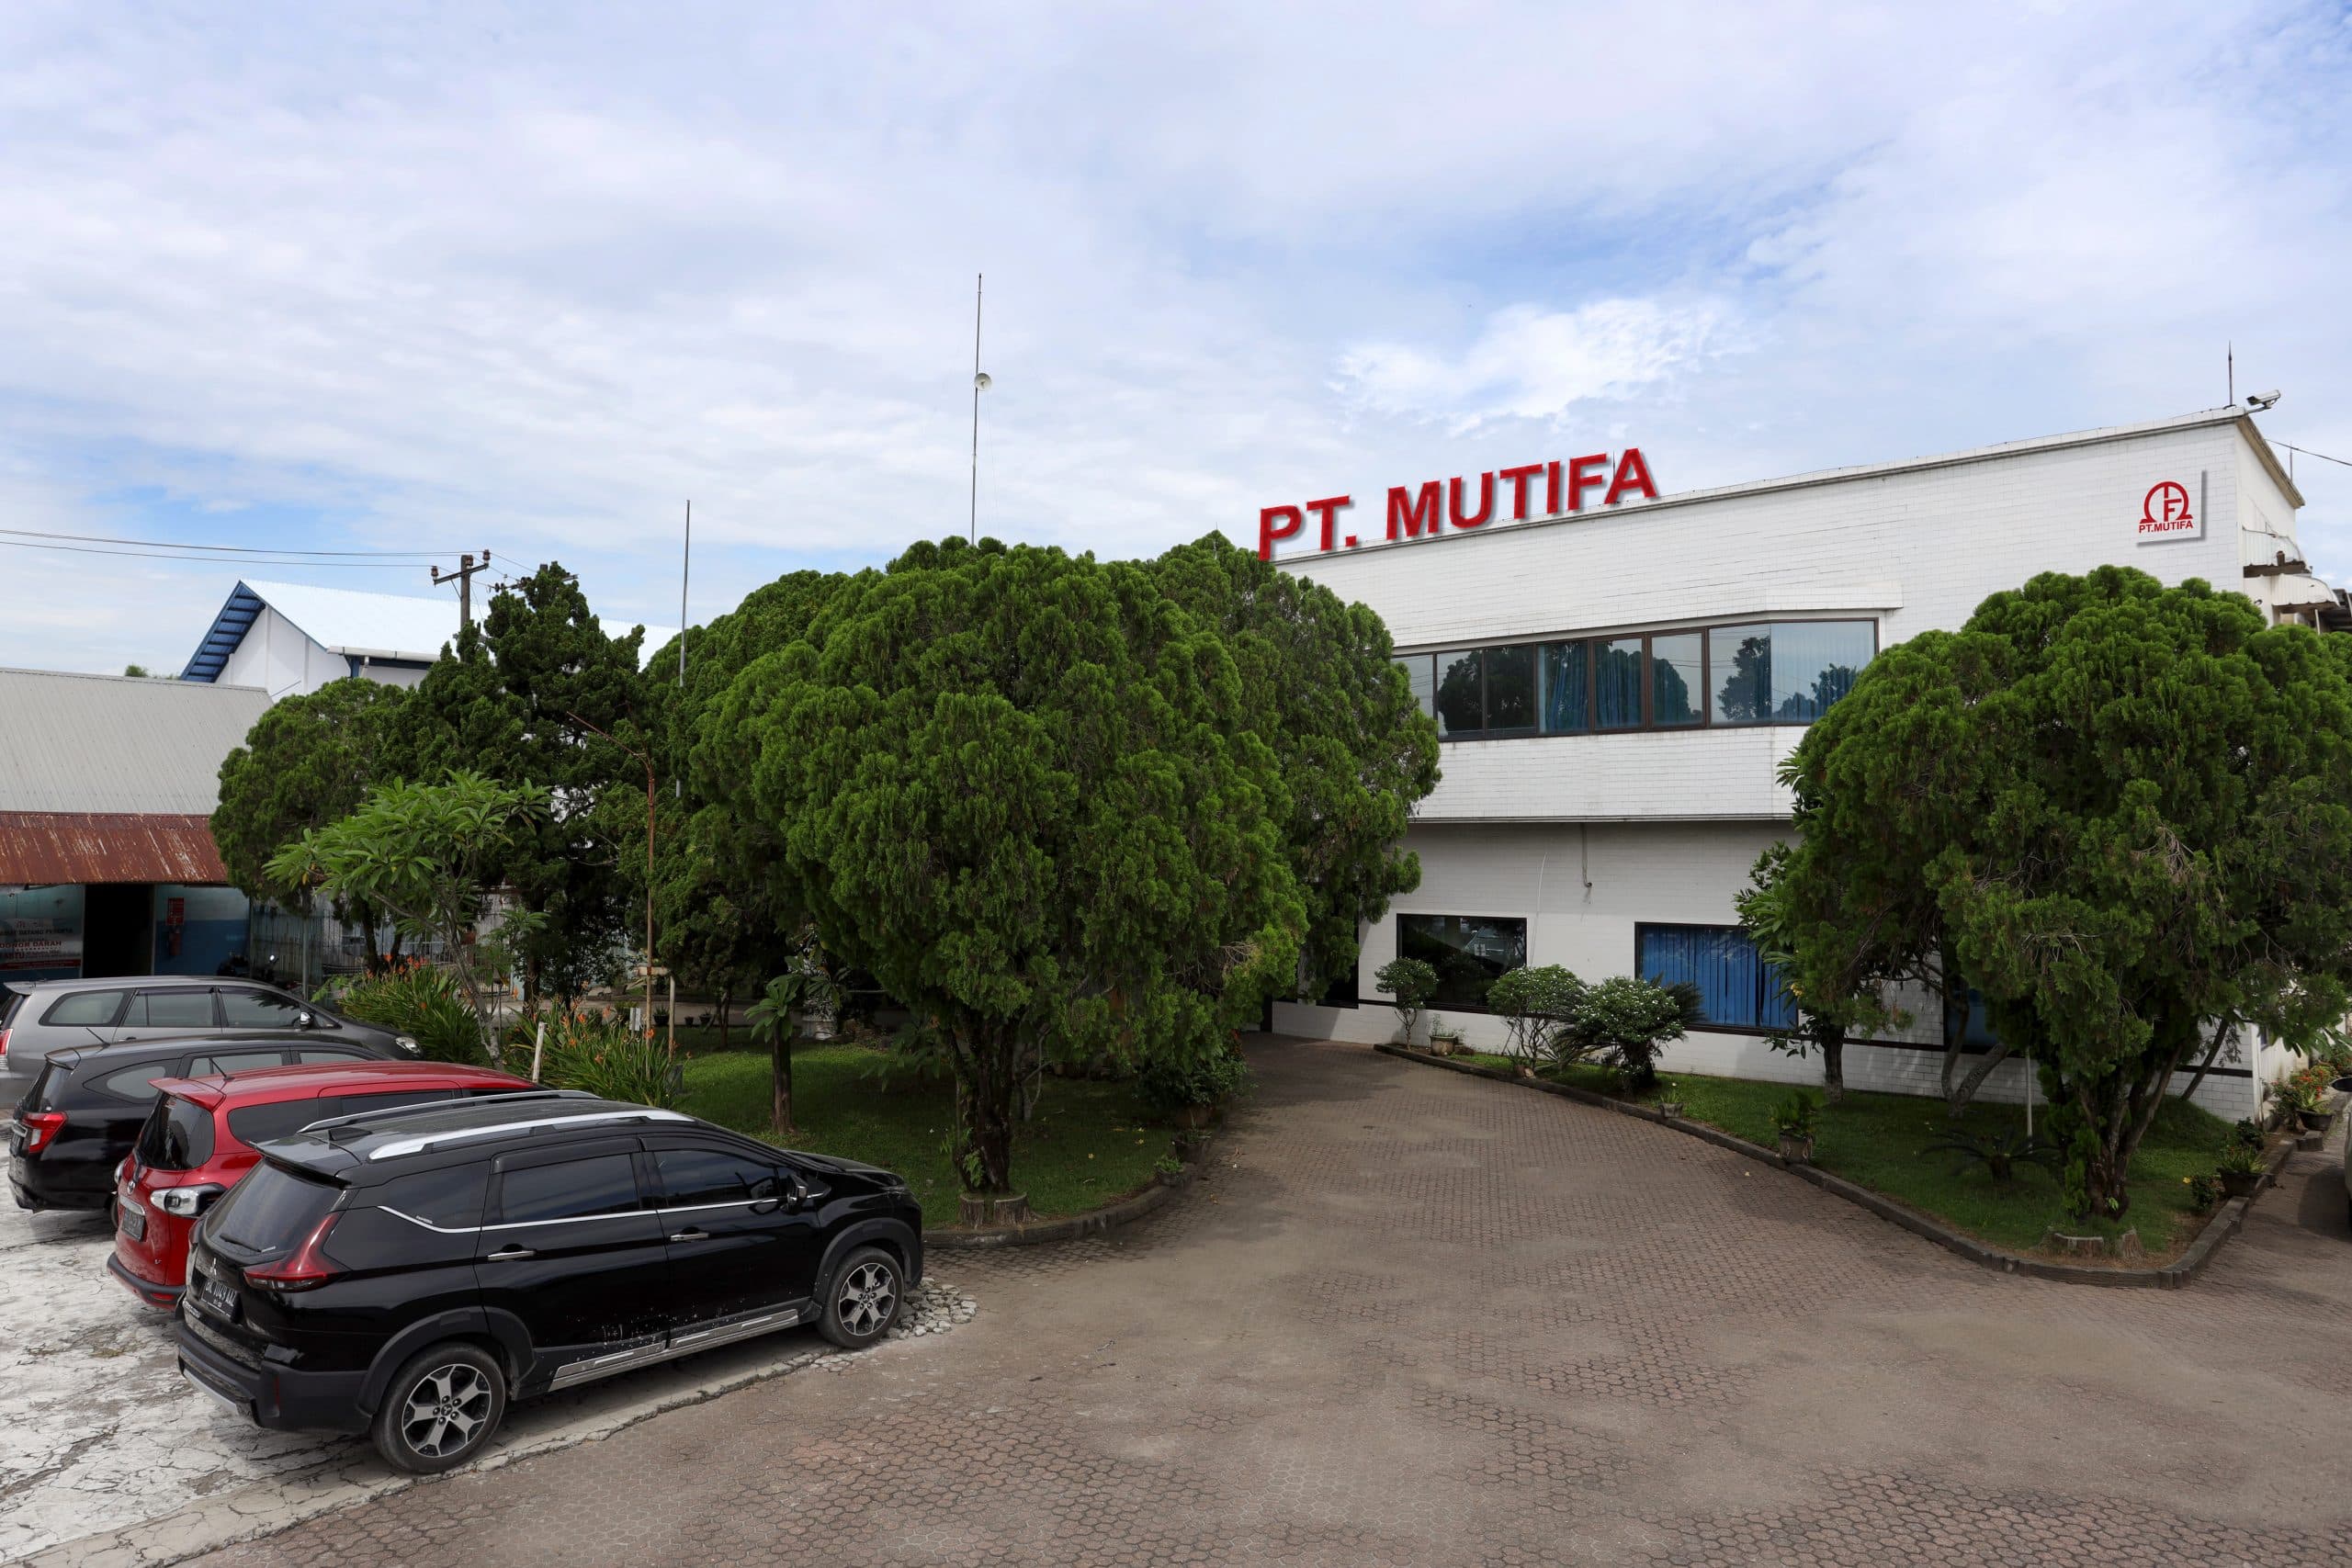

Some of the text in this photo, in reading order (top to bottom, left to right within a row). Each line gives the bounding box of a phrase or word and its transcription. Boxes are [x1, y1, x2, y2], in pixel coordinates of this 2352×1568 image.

[1258, 446, 1658, 562] PT. MUTIFA
[2138, 520, 2194, 534] PT.MUTIFA
